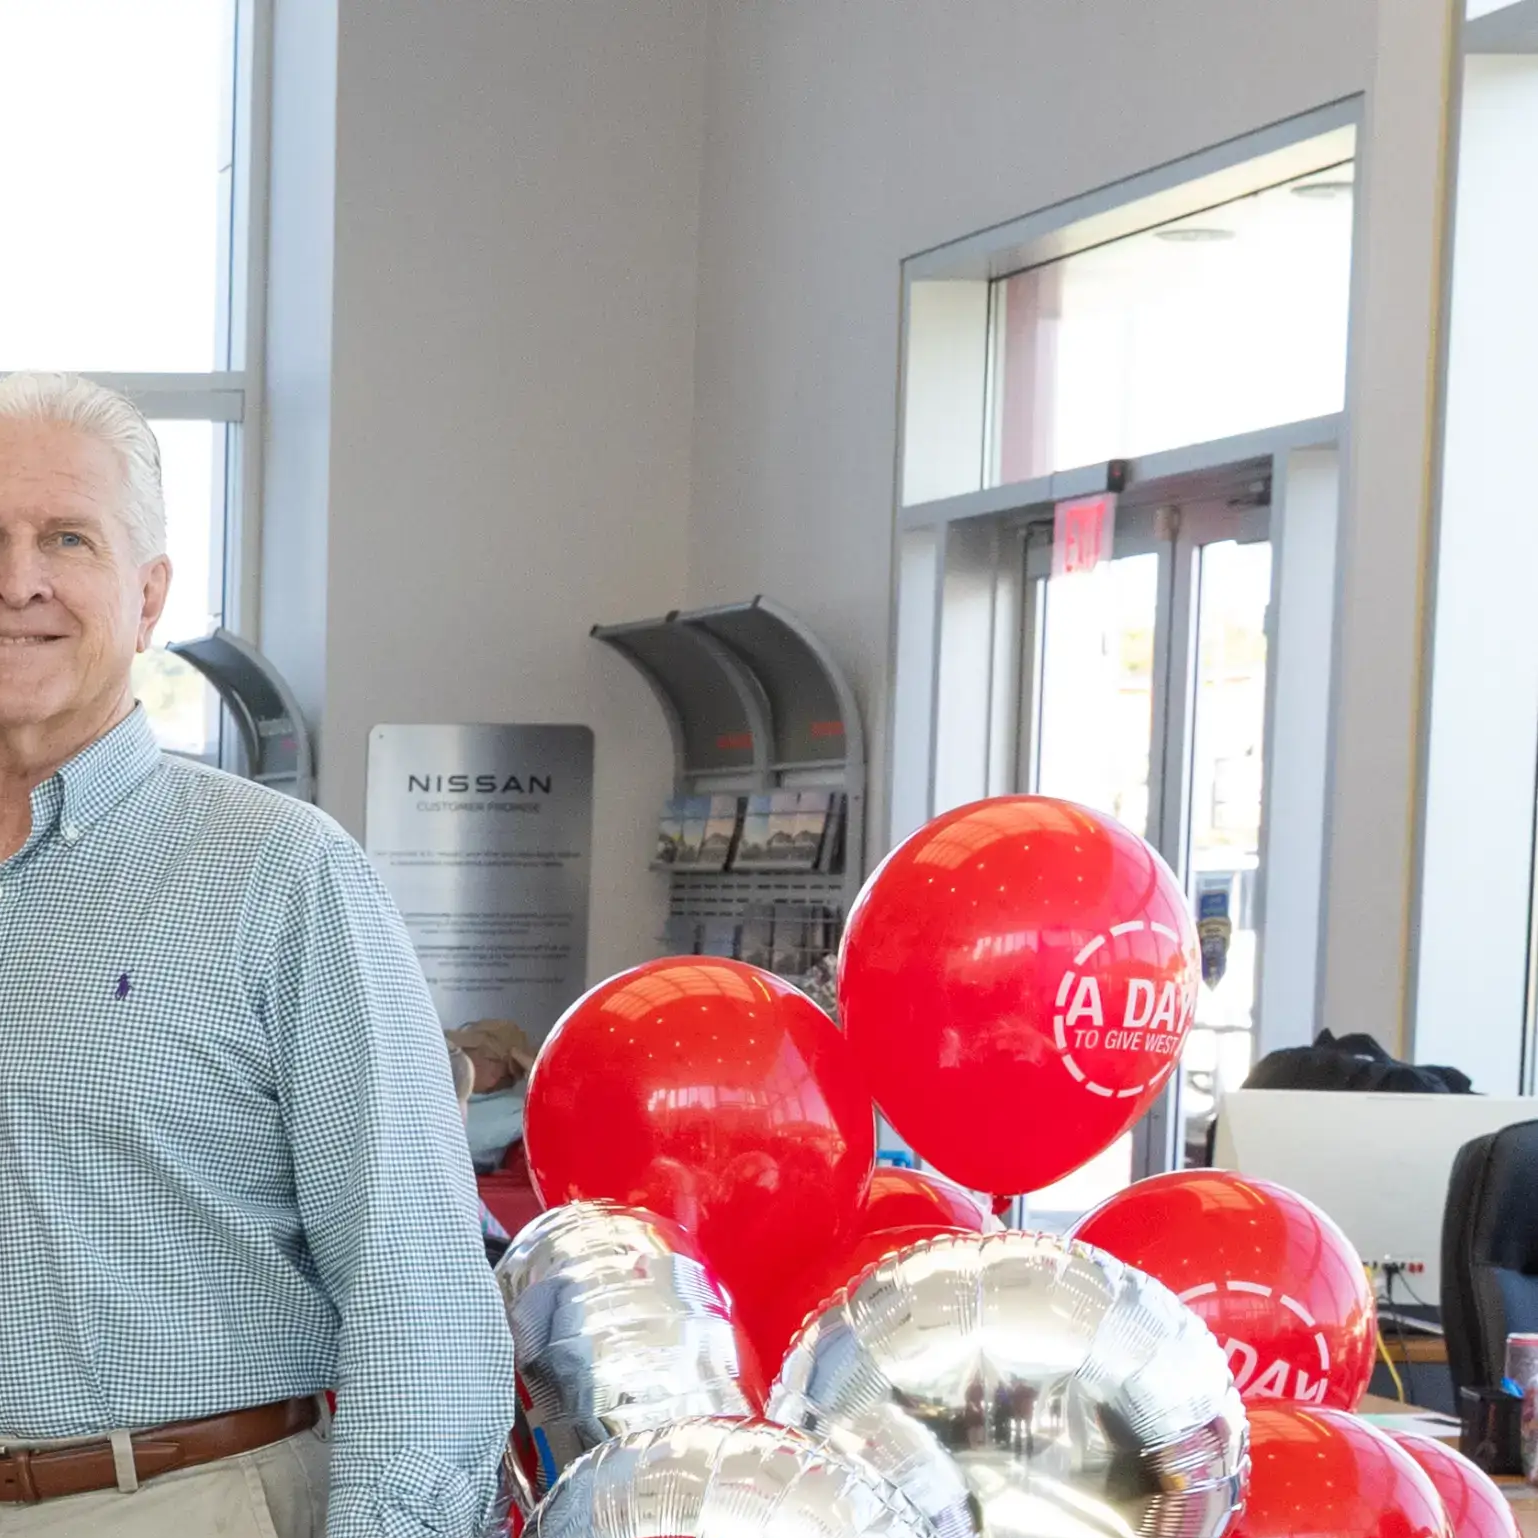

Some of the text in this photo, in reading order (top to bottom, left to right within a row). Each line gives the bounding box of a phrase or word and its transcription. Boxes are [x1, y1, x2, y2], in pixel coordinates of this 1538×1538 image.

[408, 774, 552, 795] NISSAN
[416, 801, 484, 813] CUSTOMER
[1065, 976, 1193, 1034] A DAY
[1074, 1029, 1179, 1055] TO GIVE WEST
